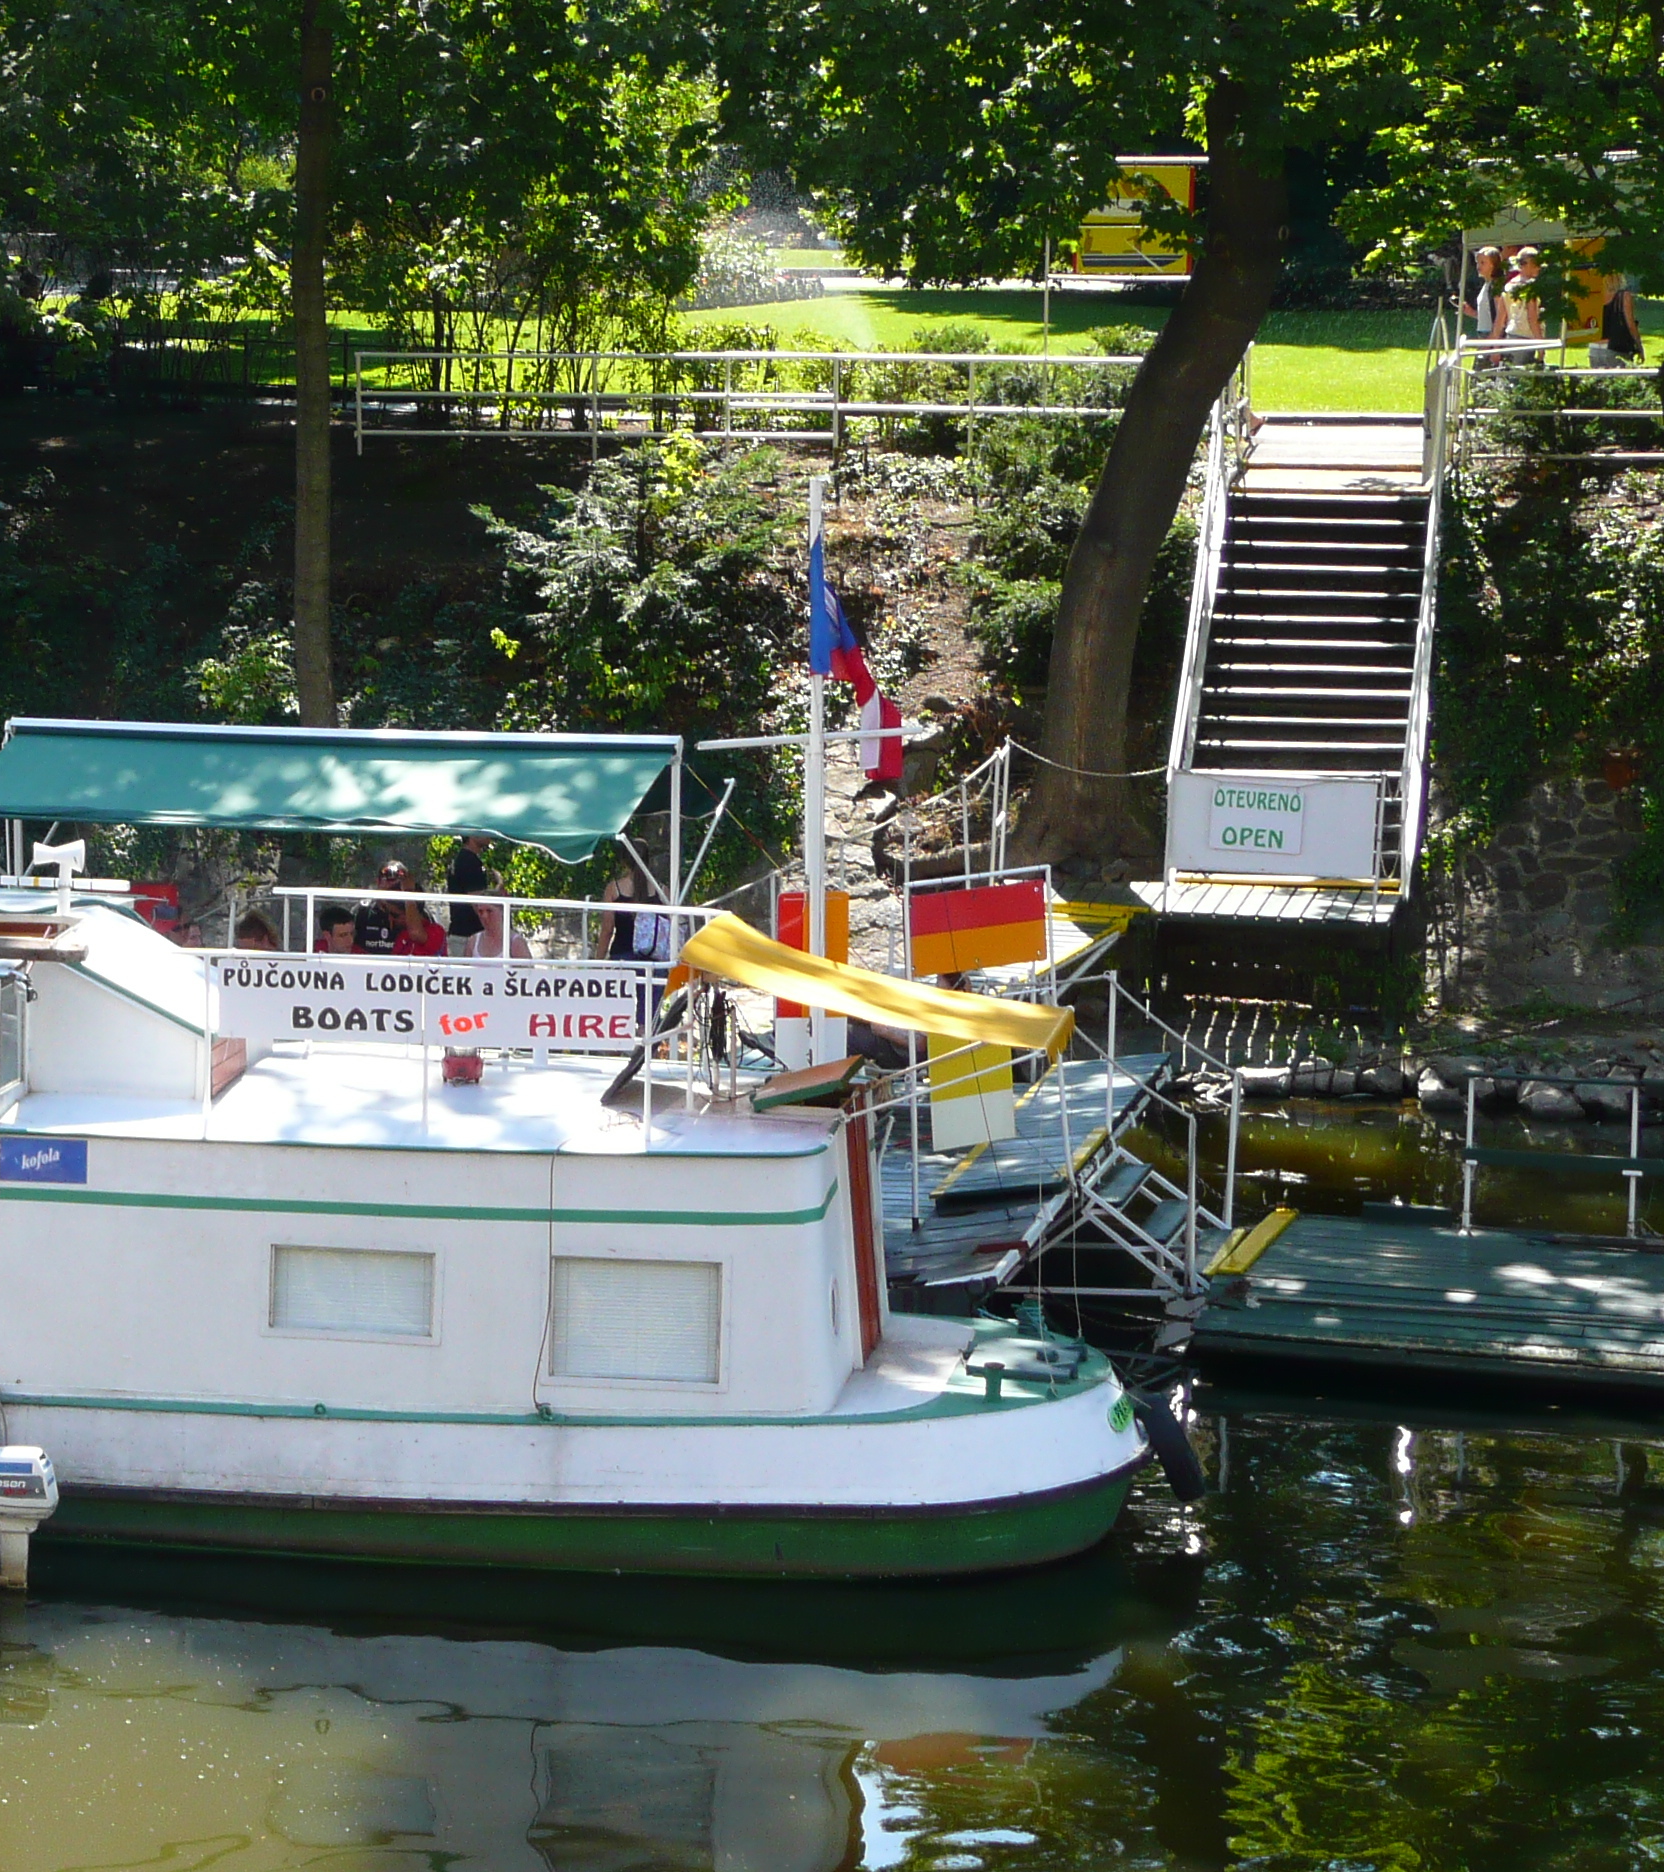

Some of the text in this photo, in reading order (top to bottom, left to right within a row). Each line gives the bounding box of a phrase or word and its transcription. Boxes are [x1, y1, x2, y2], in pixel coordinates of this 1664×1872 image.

[1221, 826, 1284, 849] OPEN
[365, 940, 395, 949] norther
[223, 960, 633, 999] PŮJČOVNA LODIČEK a ŠLAPADEL
[292, 1005, 632, 1039] BOATS for HIRE
[21, 1147, 60, 1170] kofola
